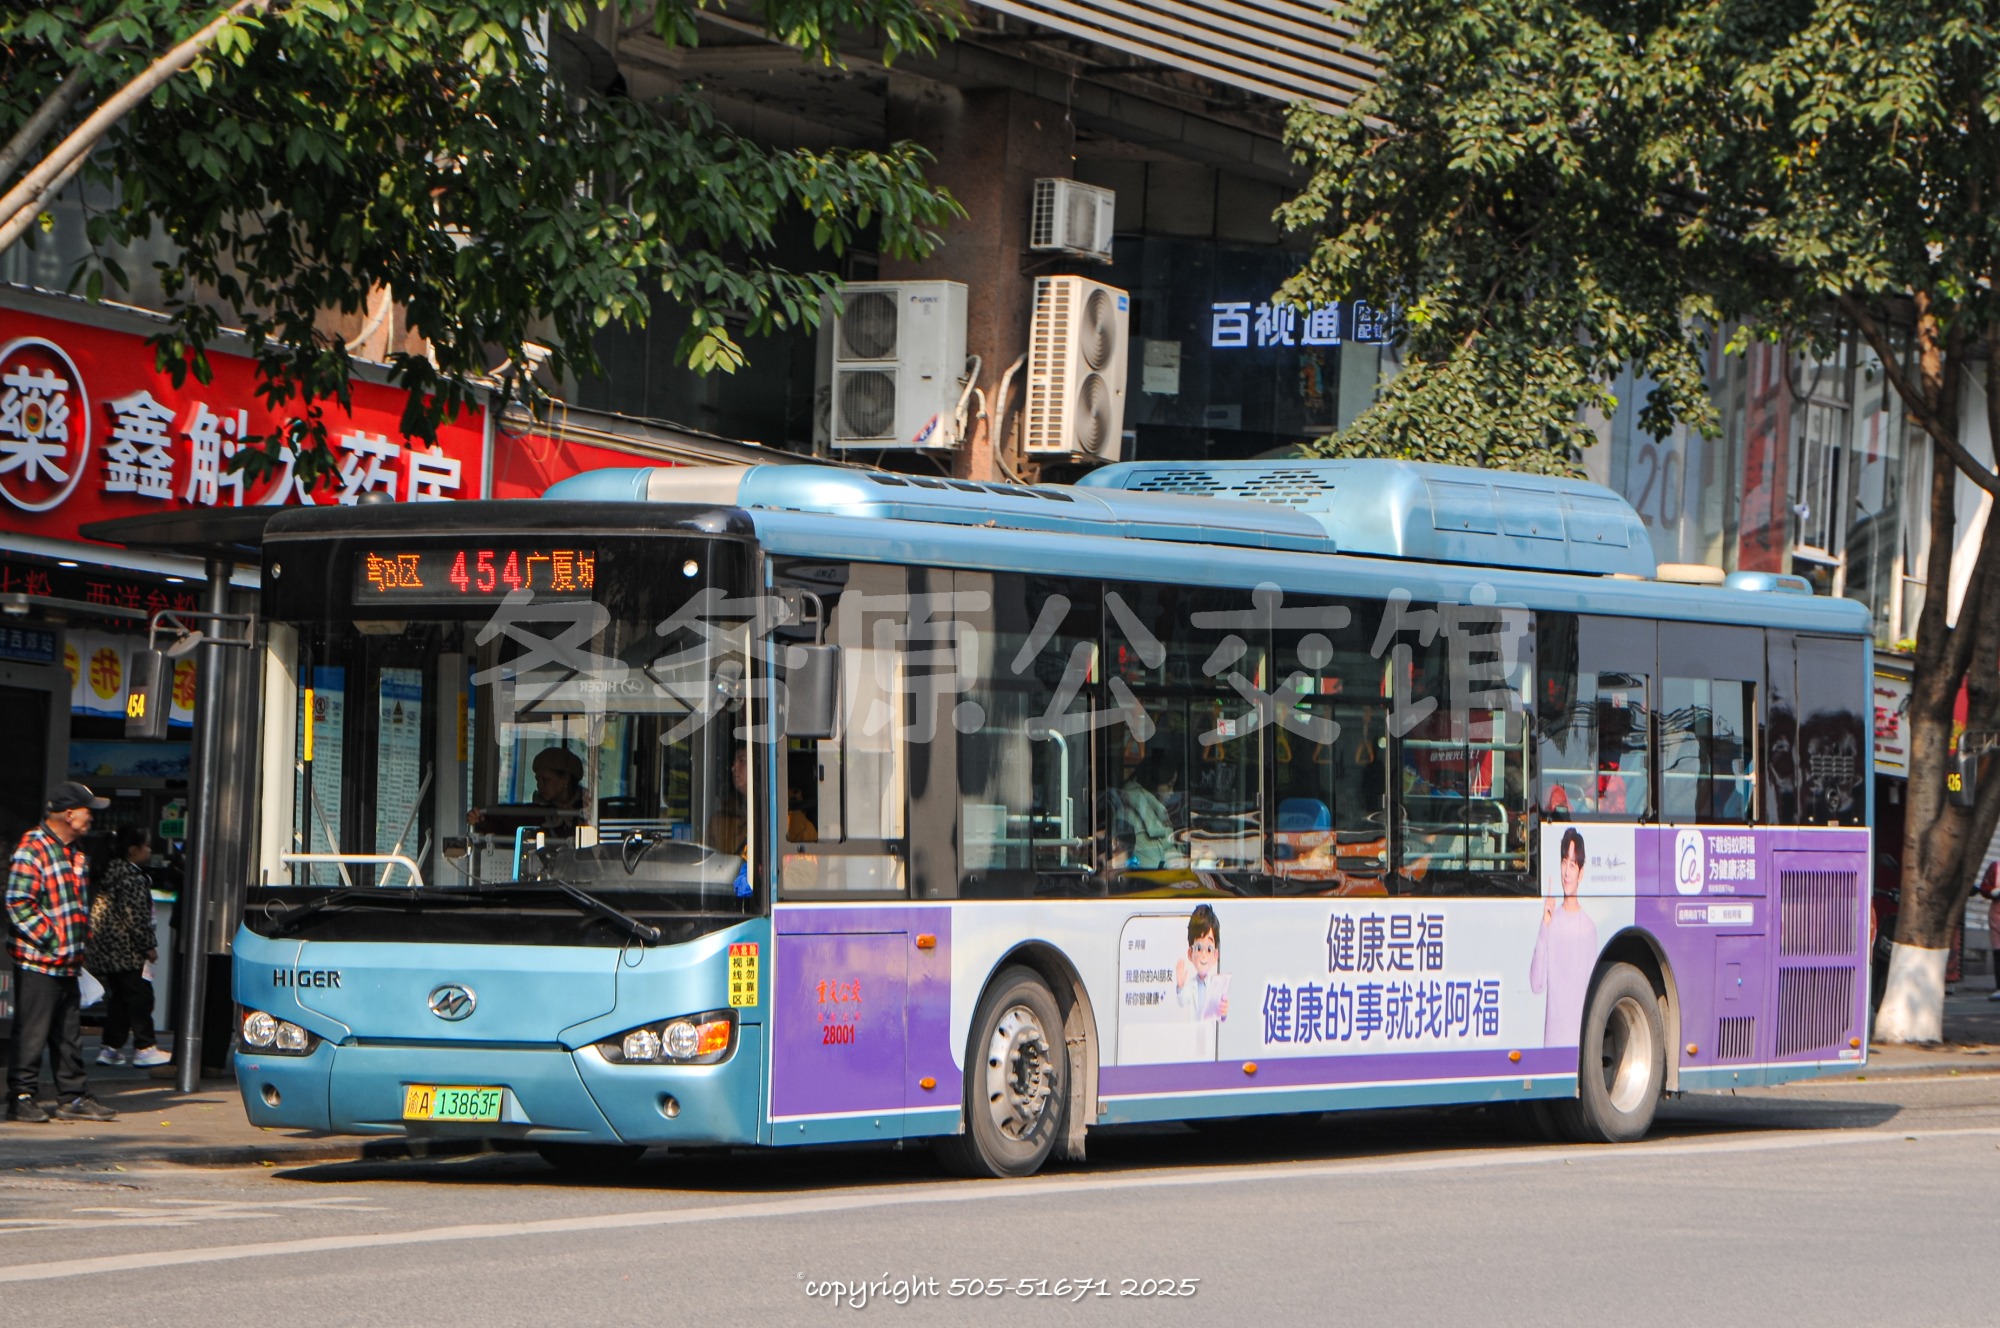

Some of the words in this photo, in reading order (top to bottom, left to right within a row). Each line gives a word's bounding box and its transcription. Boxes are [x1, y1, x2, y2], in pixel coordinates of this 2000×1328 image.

[1212, 301, 1341, 347] 百视通
[450, 551, 522, 591] 454
[126, 693, 145, 718] 454
[1326, 911, 1445, 974] 健康是福
[273, 968, 341, 988] HIGER
[733, 957, 742, 1005] 视线盲区
[746, 957, 755, 1004] 请勿靠近
[823, 1025, 856, 1045] 28001
[1262, 979, 1501, 1045] 健康的事就找阿福
